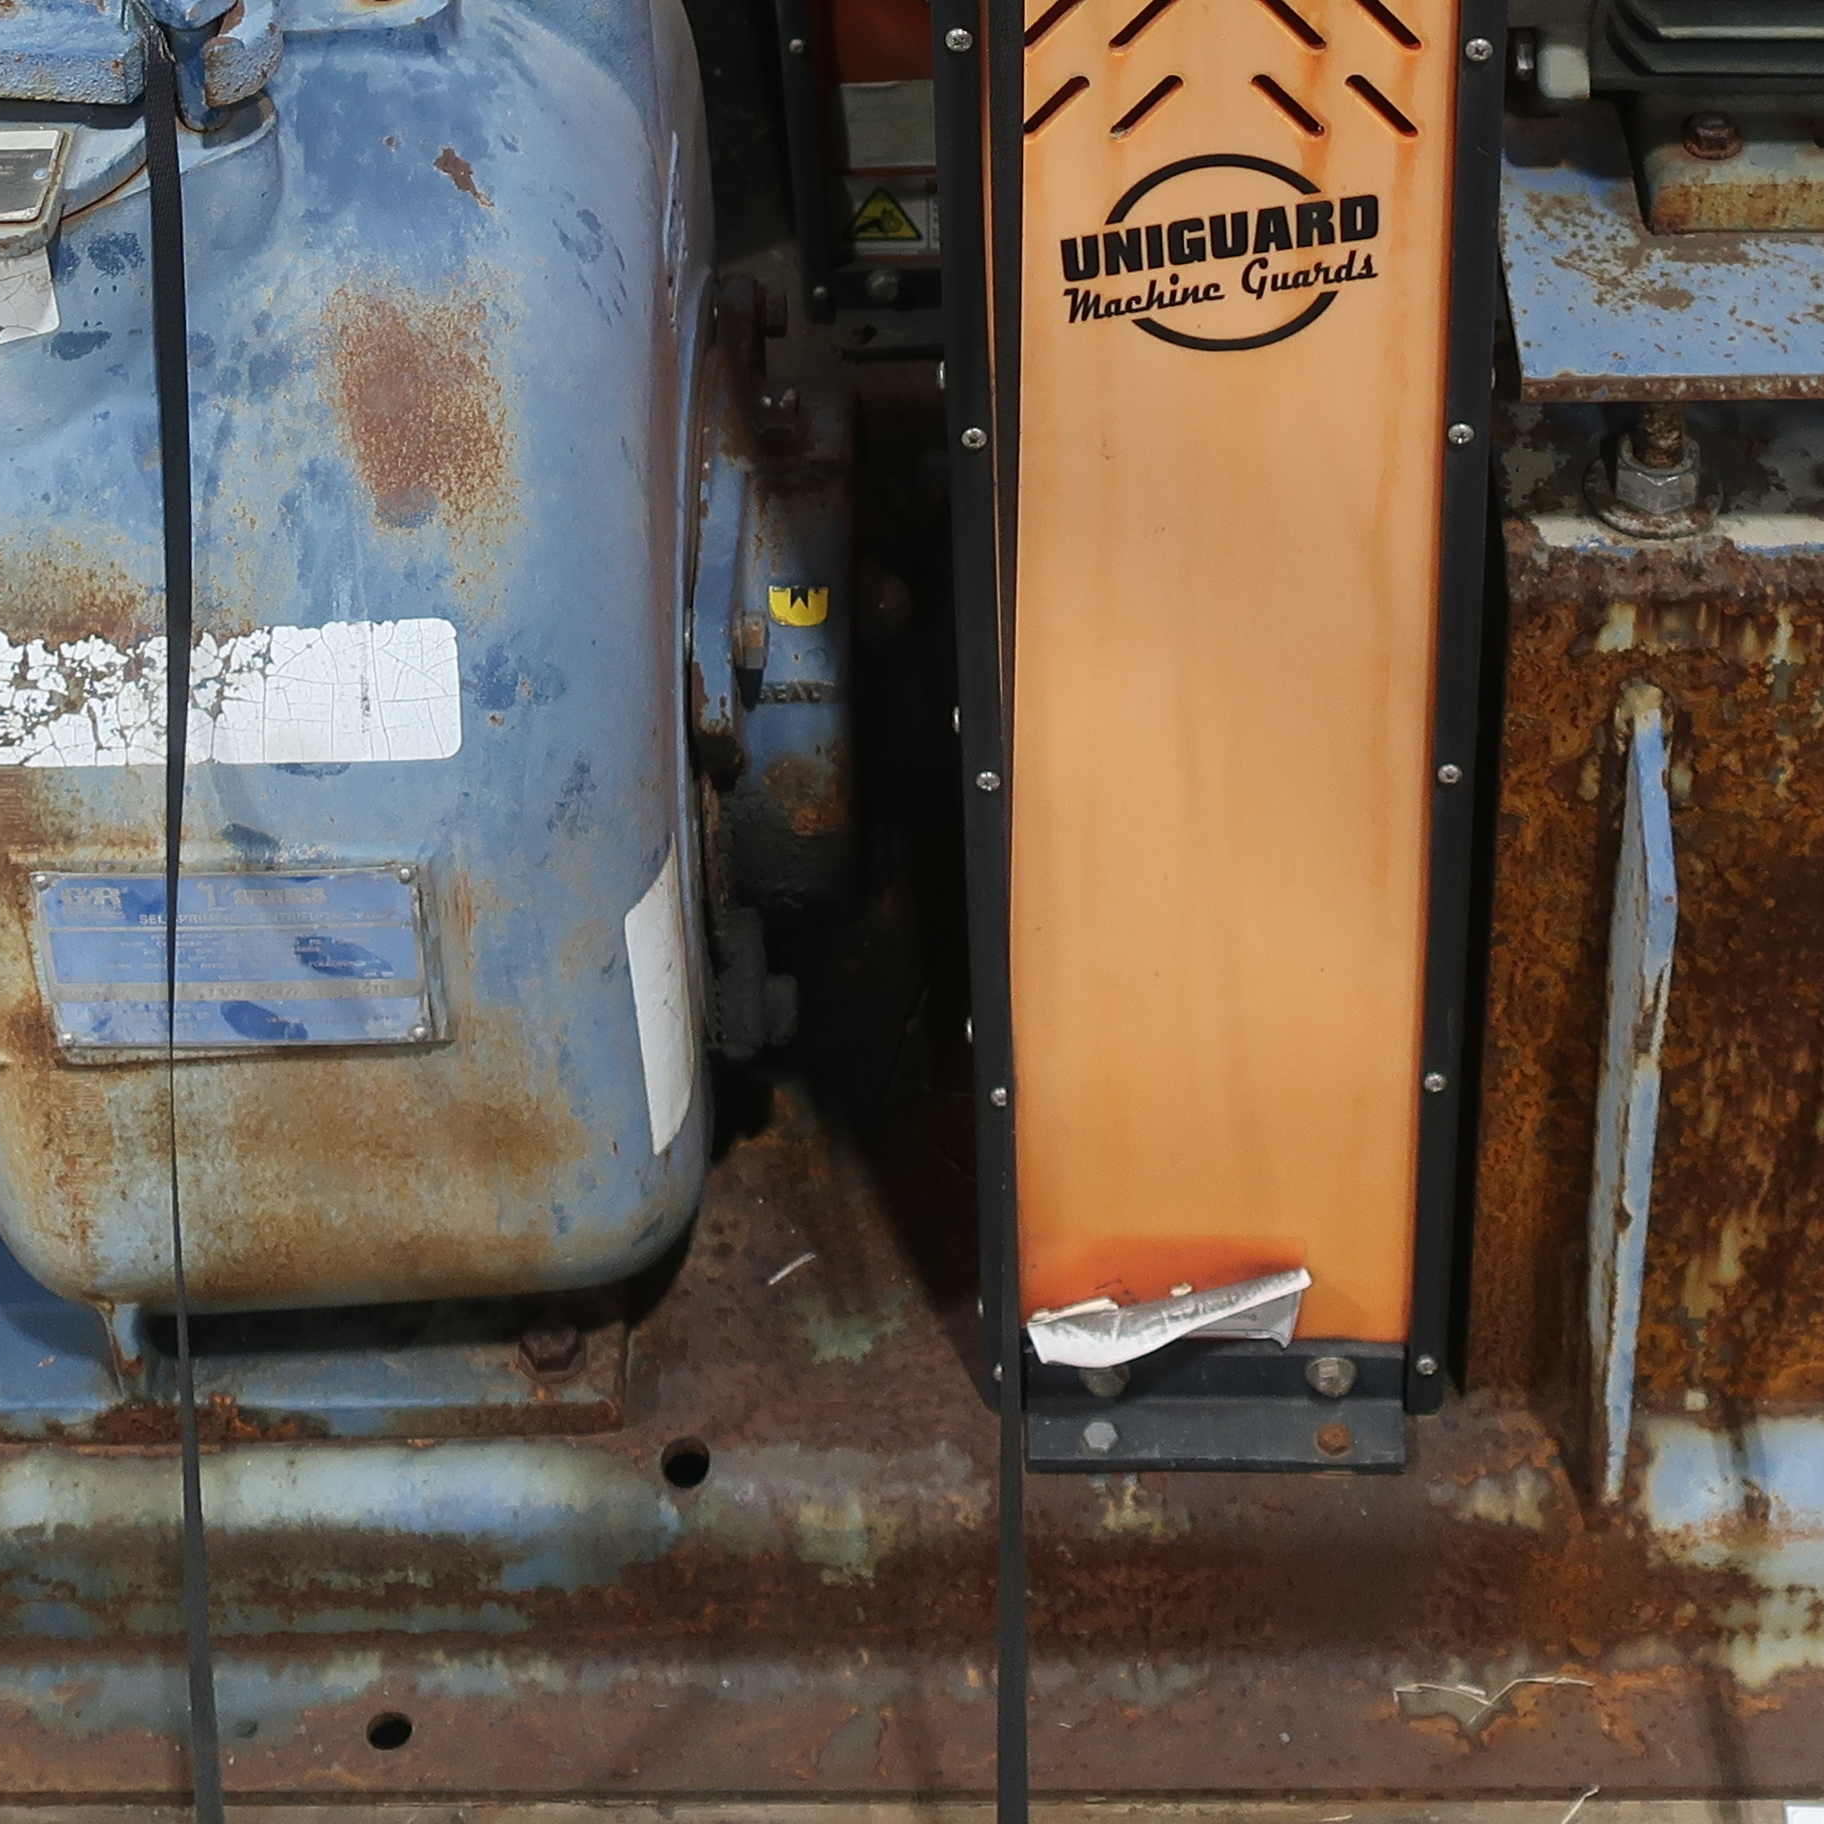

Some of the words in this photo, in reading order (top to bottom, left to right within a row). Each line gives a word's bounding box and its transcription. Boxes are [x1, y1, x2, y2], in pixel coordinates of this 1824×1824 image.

[1060, 194, 1380, 282] UNIGUARD
[1063, 273, 1225, 323] Machine
[1240, 250, 1379, 300] Guards
